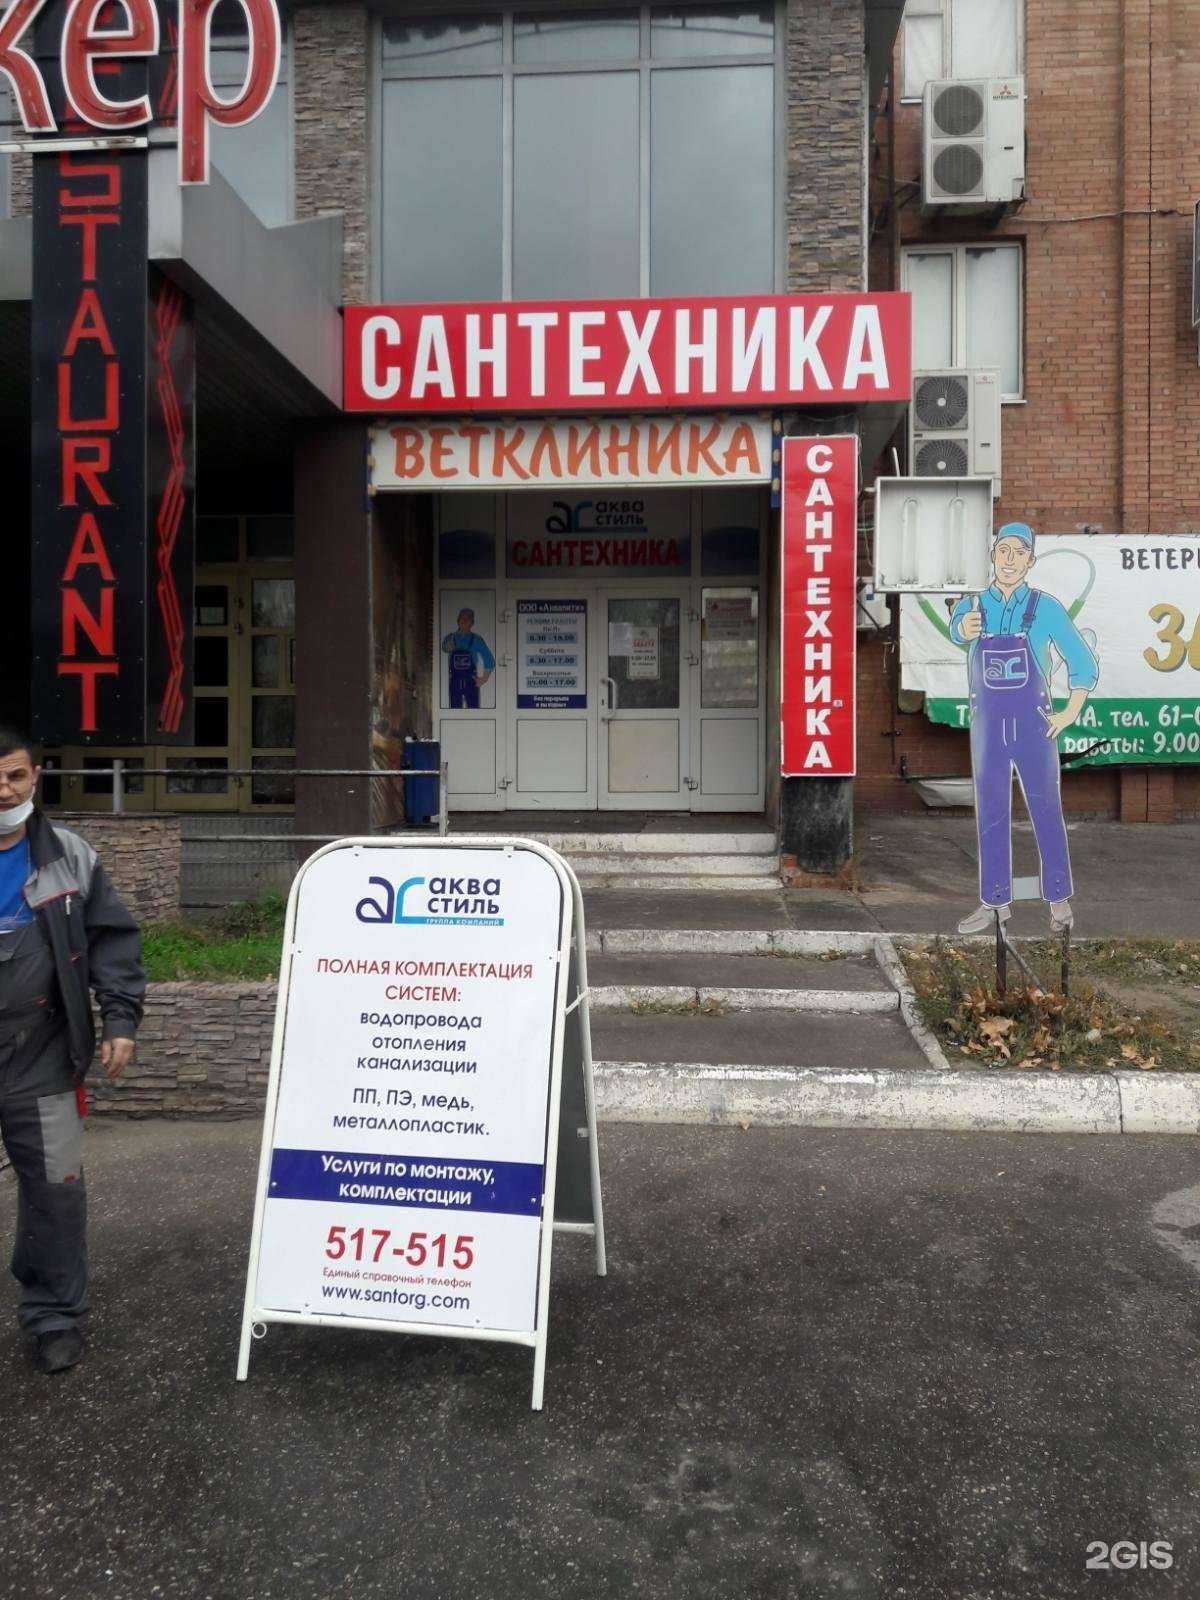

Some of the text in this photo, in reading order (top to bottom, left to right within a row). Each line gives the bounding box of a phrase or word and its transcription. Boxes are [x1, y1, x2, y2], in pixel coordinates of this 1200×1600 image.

[361, 303, 890, 400] САНТЕХНИКА
[390, 421, 761, 480] ВЕТКЛИНИКА
[595, 500, 645, 512] аква
[595, 514, 645, 526] стиль
[512, 538, 680, 567] САНТЕХНИКА
[803, 443, 834, 769] САНТЕХНИКА
[1110, 710, 1150, 728] тел.
[428, 876, 501, 896] аква
[427, 897, 500, 915] стиль
[316, 958, 533, 981] ПОЛНАЯ КОМПЛЕКТАЦИЯ
[385, 985, 461, 1003] СИСТЕМ:
[360, 1011, 482, 1030] водопровода
[372, 1035, 467, 1051] отопления
[356, 1055, 477, 1074] канализации
[352, 1087, 475, 1112] ПП, ПЭ, медь,
[332, 1114, 490, 1136] металлопластик.
[321, 1154, 496, 1185] Услуги по монтажу,
[339, 1182, 472, 1206] комплектации
[325, 1225, 475, 1271] 517-515
[322, 1266, 472, 1289] Единый справочный телефон
[322, 1284, 471, 1310] www.santorg.com
